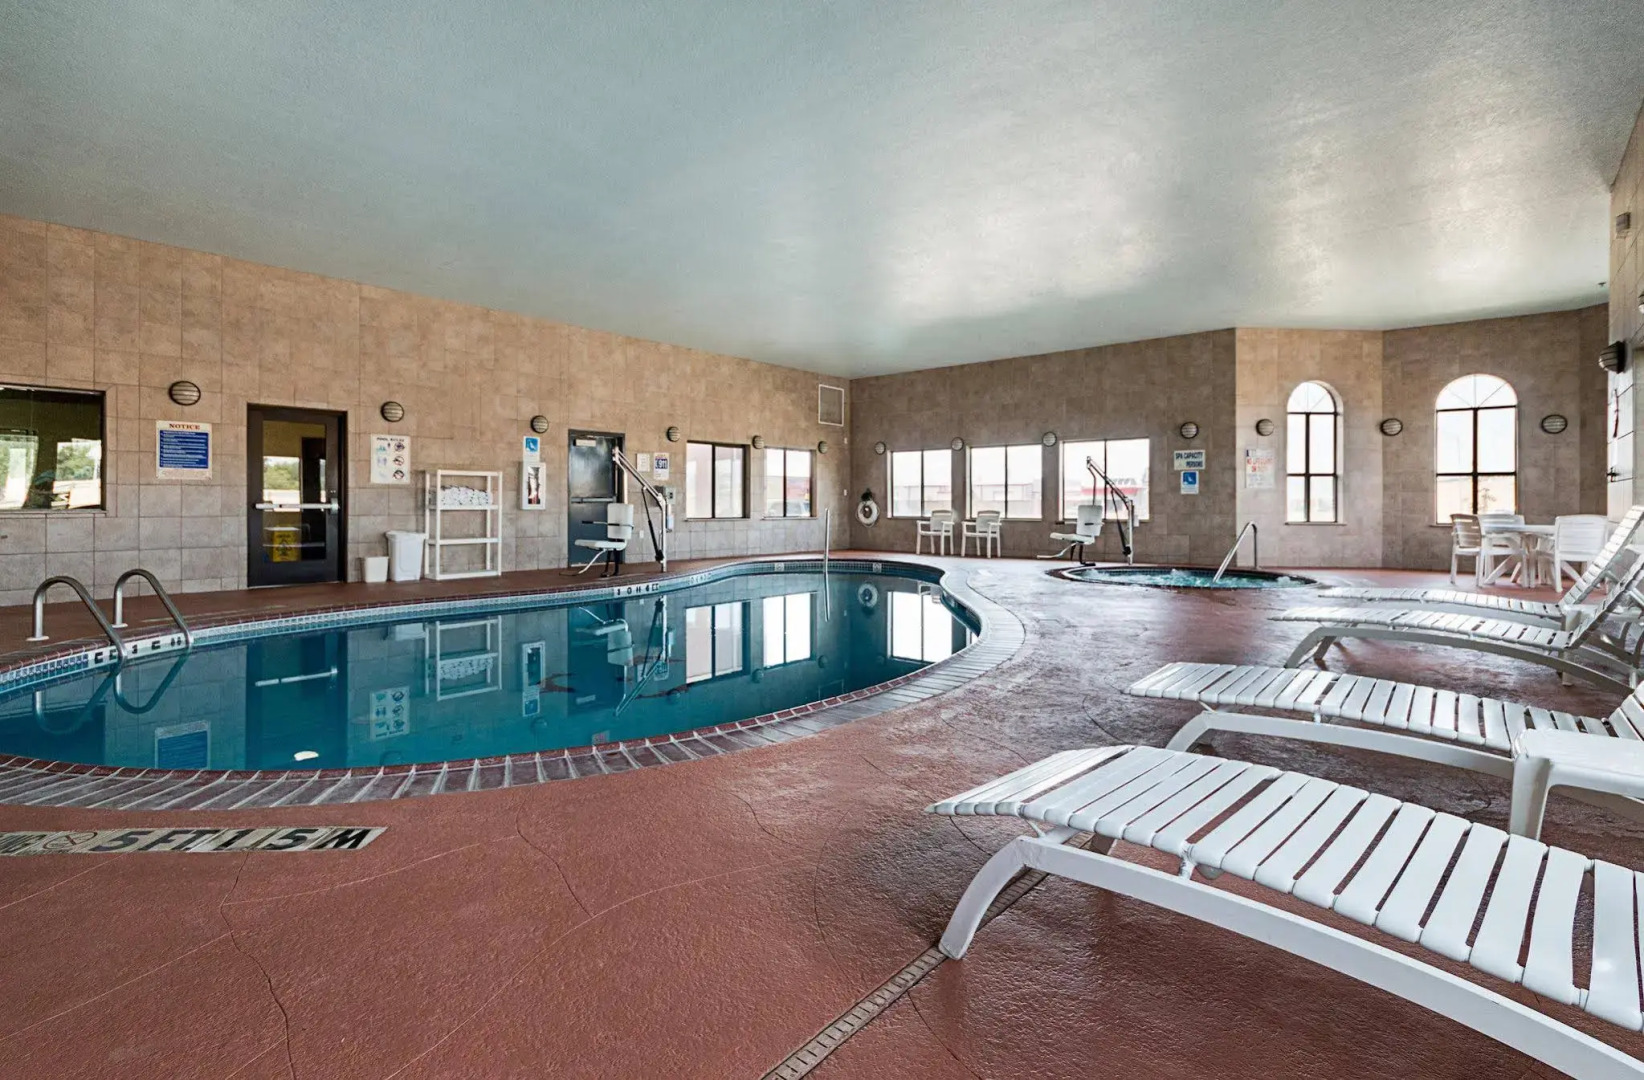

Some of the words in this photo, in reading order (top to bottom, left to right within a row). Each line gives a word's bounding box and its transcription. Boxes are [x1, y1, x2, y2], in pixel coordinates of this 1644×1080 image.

[1175, 452, 1183, 460] SPA
[1184, 451, 1203, 459] CAPACITY
[89, 830, 153, 851] 5
